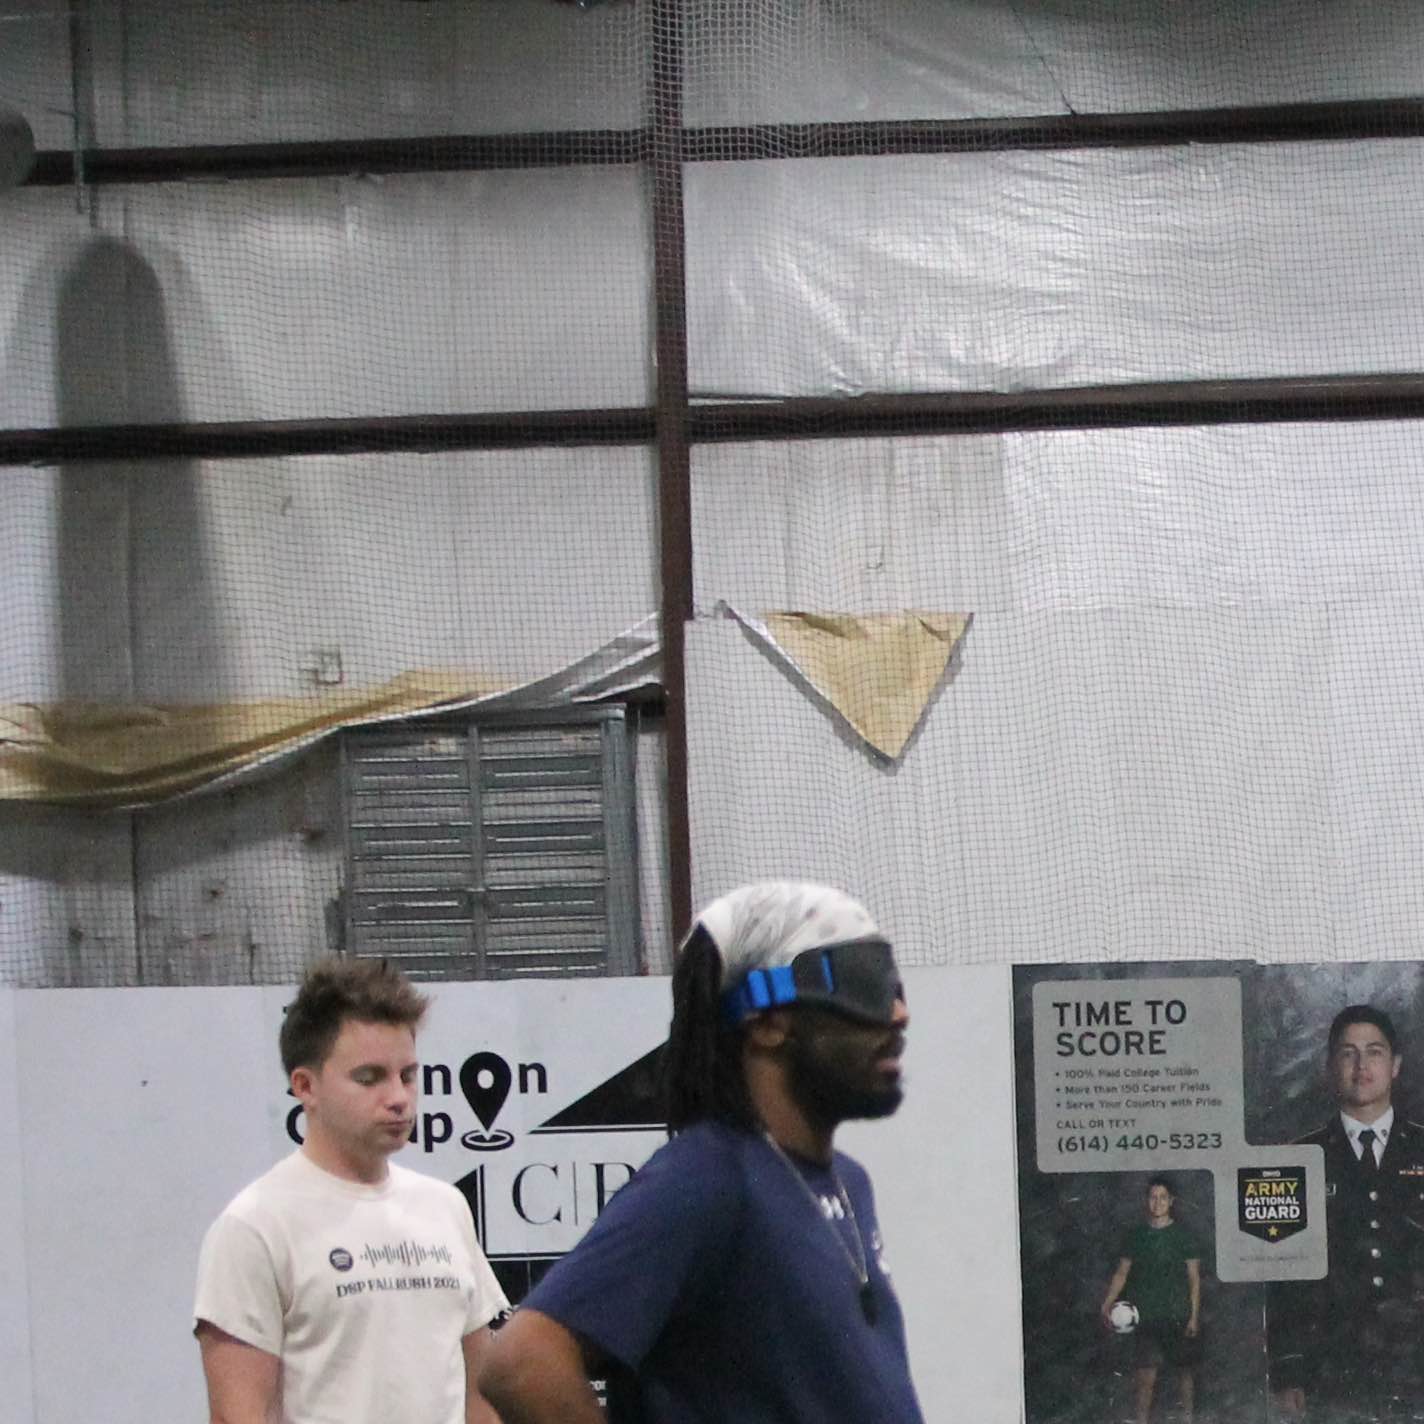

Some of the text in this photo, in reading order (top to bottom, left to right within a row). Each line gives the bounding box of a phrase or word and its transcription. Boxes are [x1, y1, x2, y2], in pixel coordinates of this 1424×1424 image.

[1052, 999, 1187, 1027] TIME TO
[1056, 1030, 1167, 1056] SCORE
[1124, 1067, 1161, 1078] College
[1125, 1099, 1166, 1109] Country
[1056, 1118, 1137, 1129] CALL OR TEXT
[1057, 1132, 1223, 1153] (614) 440-5323
[1245, 1181, 1298, 1196] ARMY
[1244, 1196, 1300, 1206] NATIONAL
[1244, 1205, 1300, 1220] GUARD
